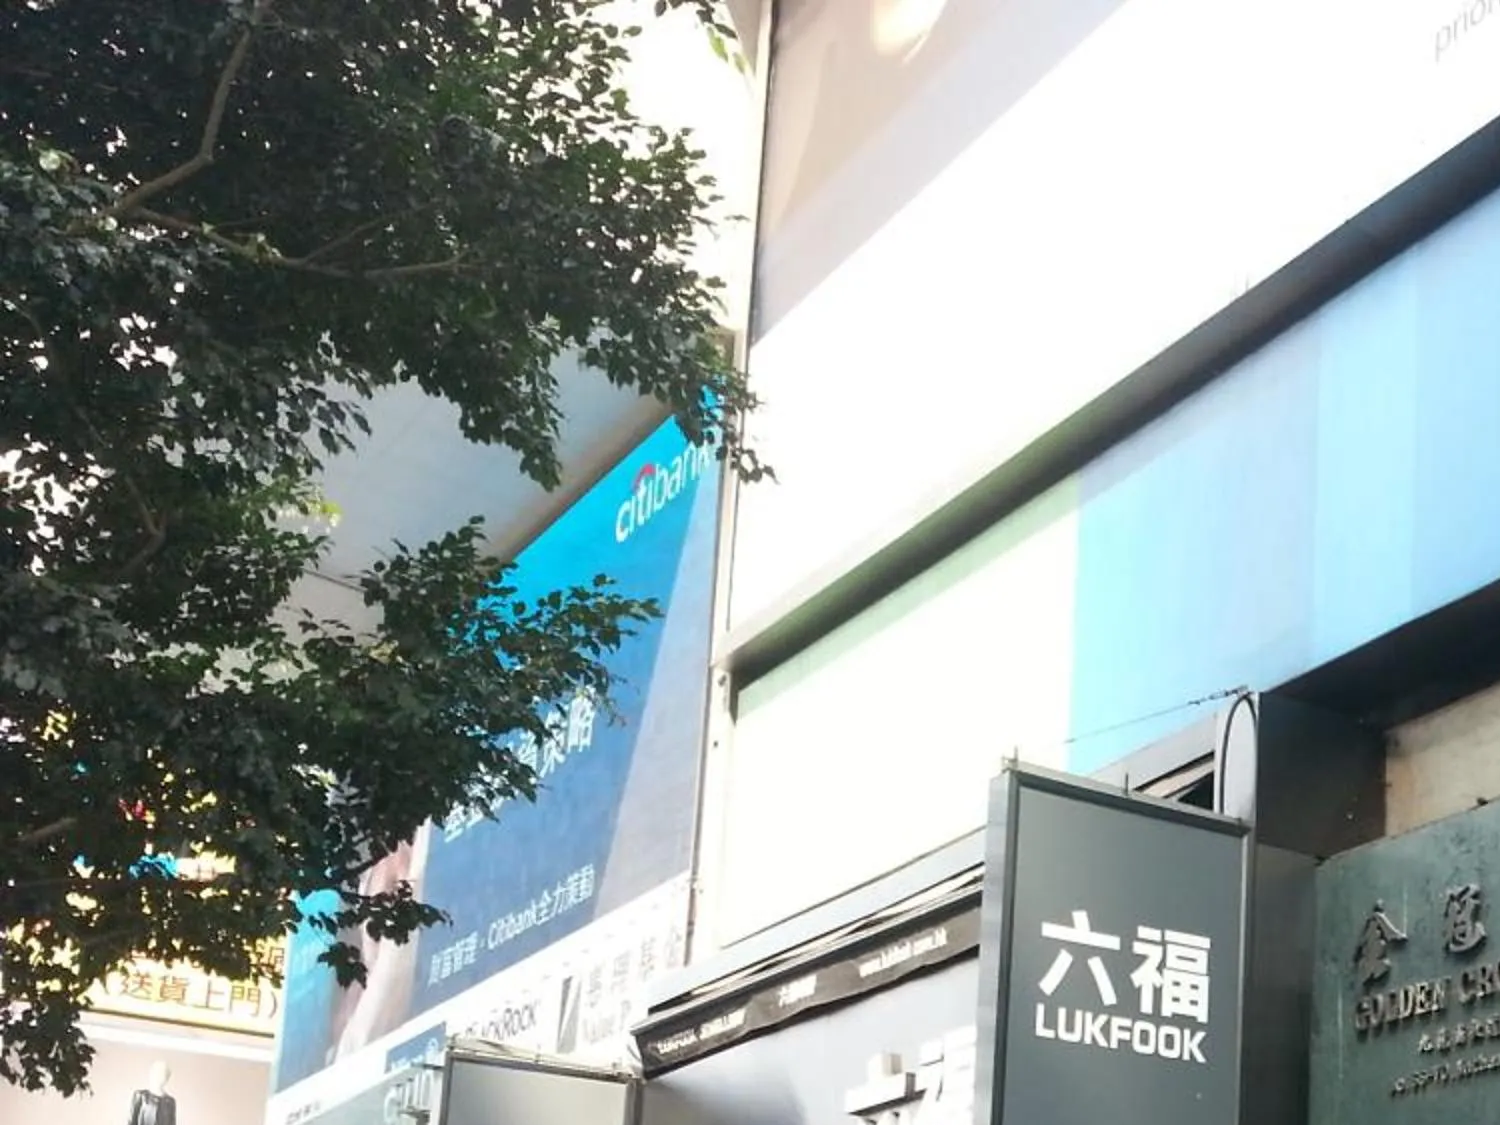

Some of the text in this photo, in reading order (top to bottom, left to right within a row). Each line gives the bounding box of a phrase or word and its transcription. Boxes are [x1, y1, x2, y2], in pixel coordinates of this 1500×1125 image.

[1039, 911, 1212, 1023] 六福
[1035, 1003, 1207, 1064] LUKFOOK
[1355, 978, 1450, 1035] GOLDEN
